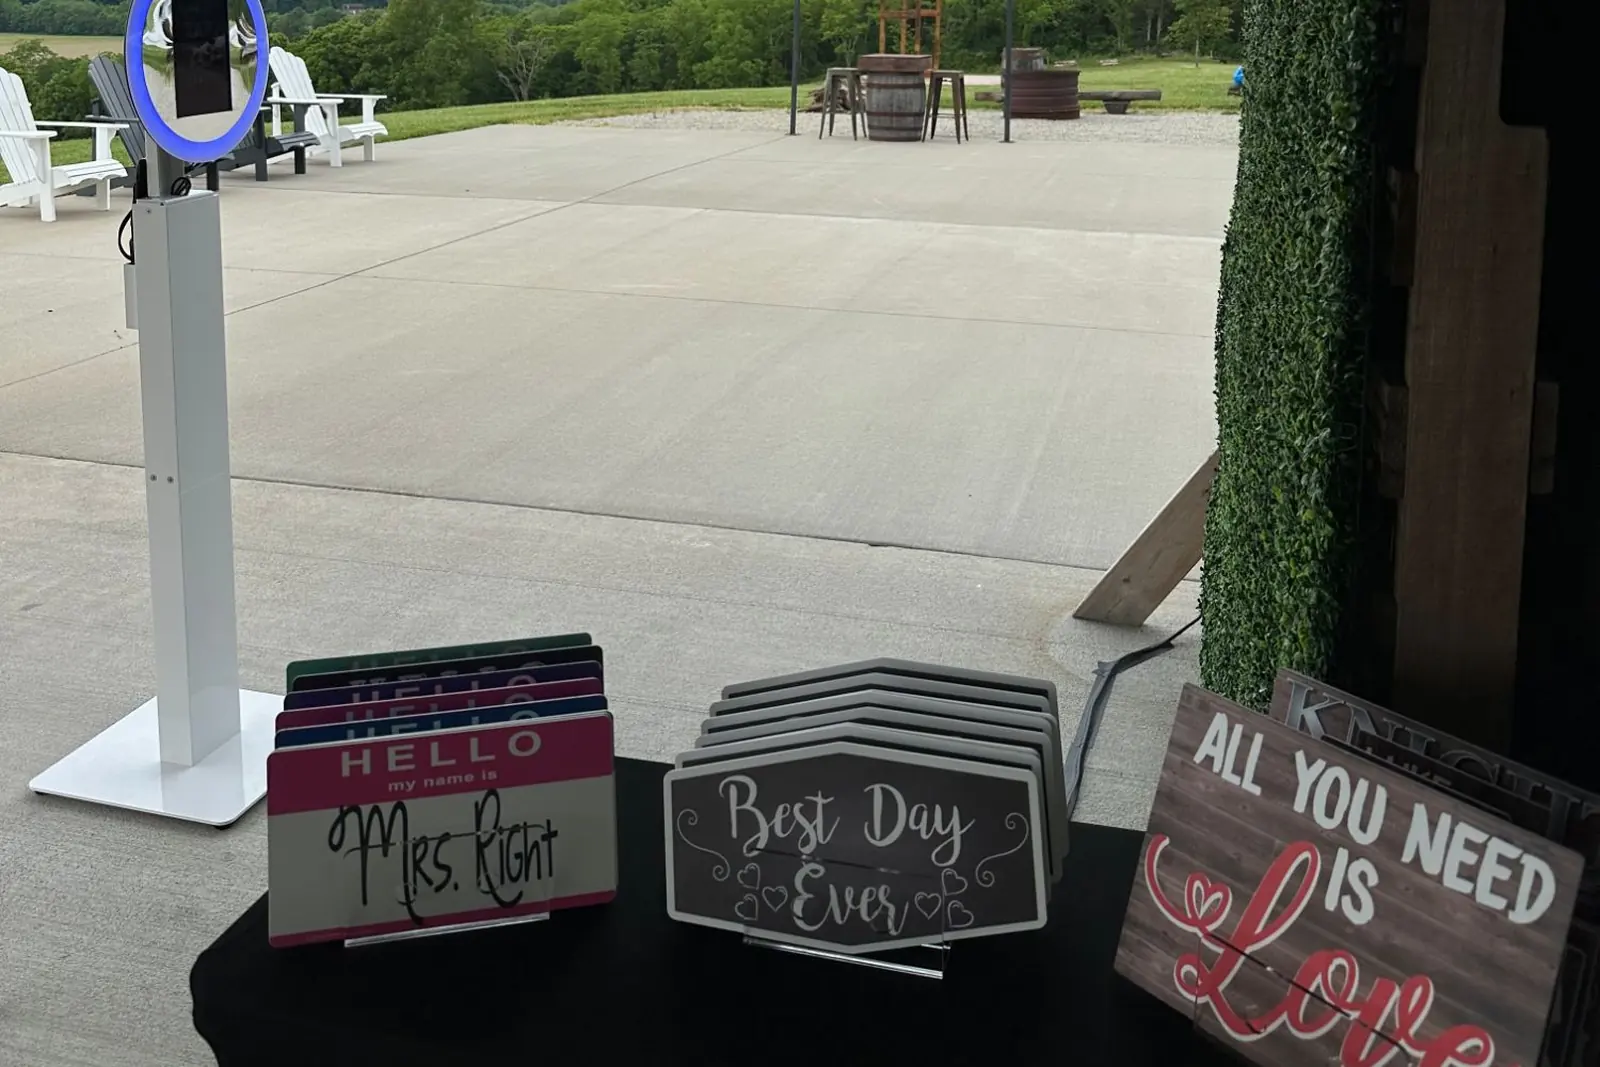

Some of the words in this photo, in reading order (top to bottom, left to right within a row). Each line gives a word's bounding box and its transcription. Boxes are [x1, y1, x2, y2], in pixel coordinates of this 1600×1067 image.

[341, 730, 541, 777] HELLO
[388, 780, 416, 792] my
[424, 773, 475, 788] name
[482, 769, 498, 781] is
[717, 775, 841, 857] Best
[863, 783, 976, 866] Day
[1193, 712, 1264, 796] ALL
[1293, 750, 1388, 845] YOU
[1401, 802, 1557, 925] NEED
[793, 861, 910, 936] Ever
[1325, 846, 1380, 926] IS
